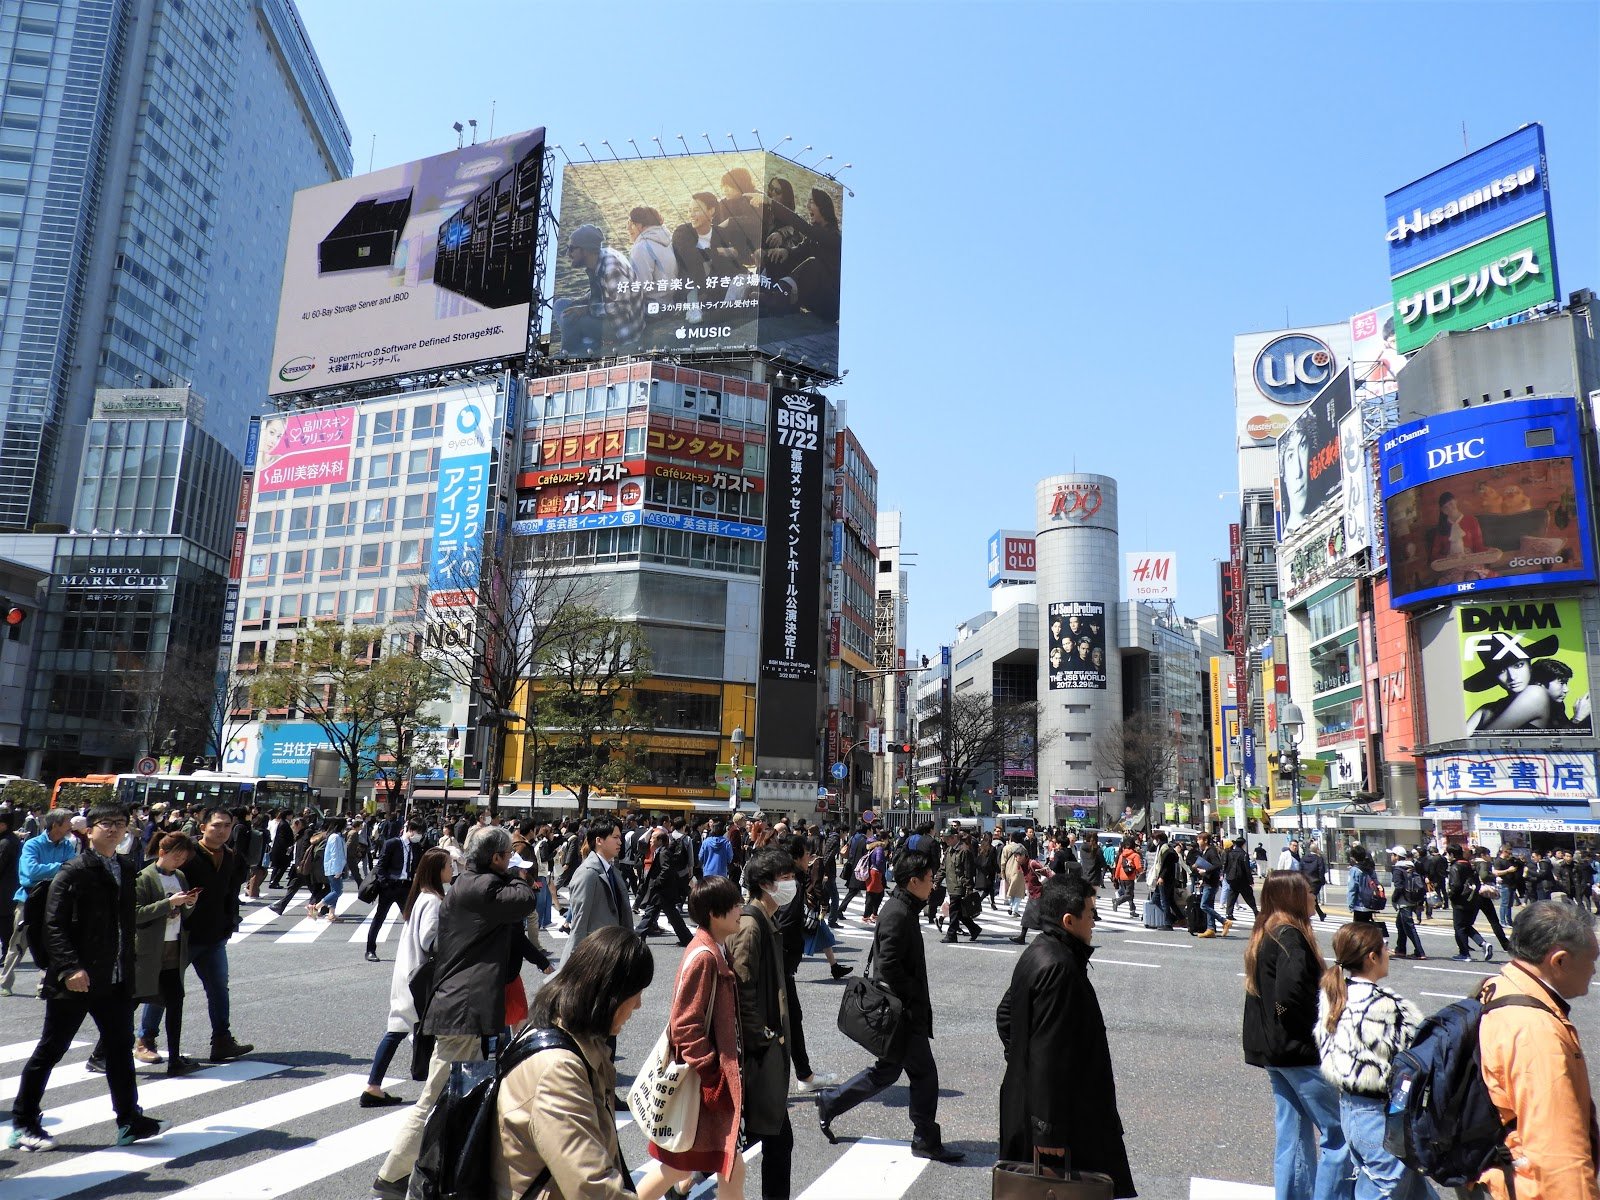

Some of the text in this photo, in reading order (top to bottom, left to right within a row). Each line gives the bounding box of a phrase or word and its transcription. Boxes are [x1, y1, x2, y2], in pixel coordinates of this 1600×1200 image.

[1385, 164, 1535, 242] Hisamitsu
[1397, 246, 1540, 326] サロンパス
[311, 308, 333, 320] 60-Bay
[333, 303, 357, 316] Storage
[357, 299, 378, 310] Server
[379, 296, 391, 305] and
[419, 335, 451, 348] Defined
[688, 326, 731, 339] MUSIC
[302, 415, 350, 434] 品川スキン
[777, 408, 818, 432] BiSH
[302, 429, 343, 446] クリニック
[648, 431, 740, 461] コンタクト
[777, 428, 818, 450] 7/22
[1385, 425, 1430, 452] DHC Channel
[1427, 437, 1485, 470] DHC
[270, 460, 344, 485] 品川美容外科
[588, 464, 628, 483] ガスト
[712, 472, 755, 493] ガスト
[518, 499, 536, 513] 7F
[541, 495, 562, 507] Café
[563, 489, 613, 515] ガスト
[622, 492, 639, 500] ガスト
[1048, 490, 1103, 521] 109
[437, 467, 465, 579] アイシティ
[459, 465, 483, 579] コンタクトの
[546, 514, 634, 531] 英会話イーオン 6F
[683, 518, 764, 538] 英会話イーオン
[1008, 541, 1033, 555] UNI
[89, 566, 141, 574] SHIBUYA
[1008, 555, 1035, 569] QLO
[1132, 558, 1170, 583] H&M
[1509, 556, 1564, 568] docomo
[61, 575, 170, 586] MARK CITY
[1457, 582, 1476, 591] DHC
[1074, 602, 1103, 615] Brothers
[1460, 603, 1562, 633] DMM
[1463, 632, 1530, 662] FX
[1049, 674, 1106, 683] THE JSB WORLD
[1431, 760, 1585, 792] 大盛堂書店
[658, 1125, 675, 1138] vie.
